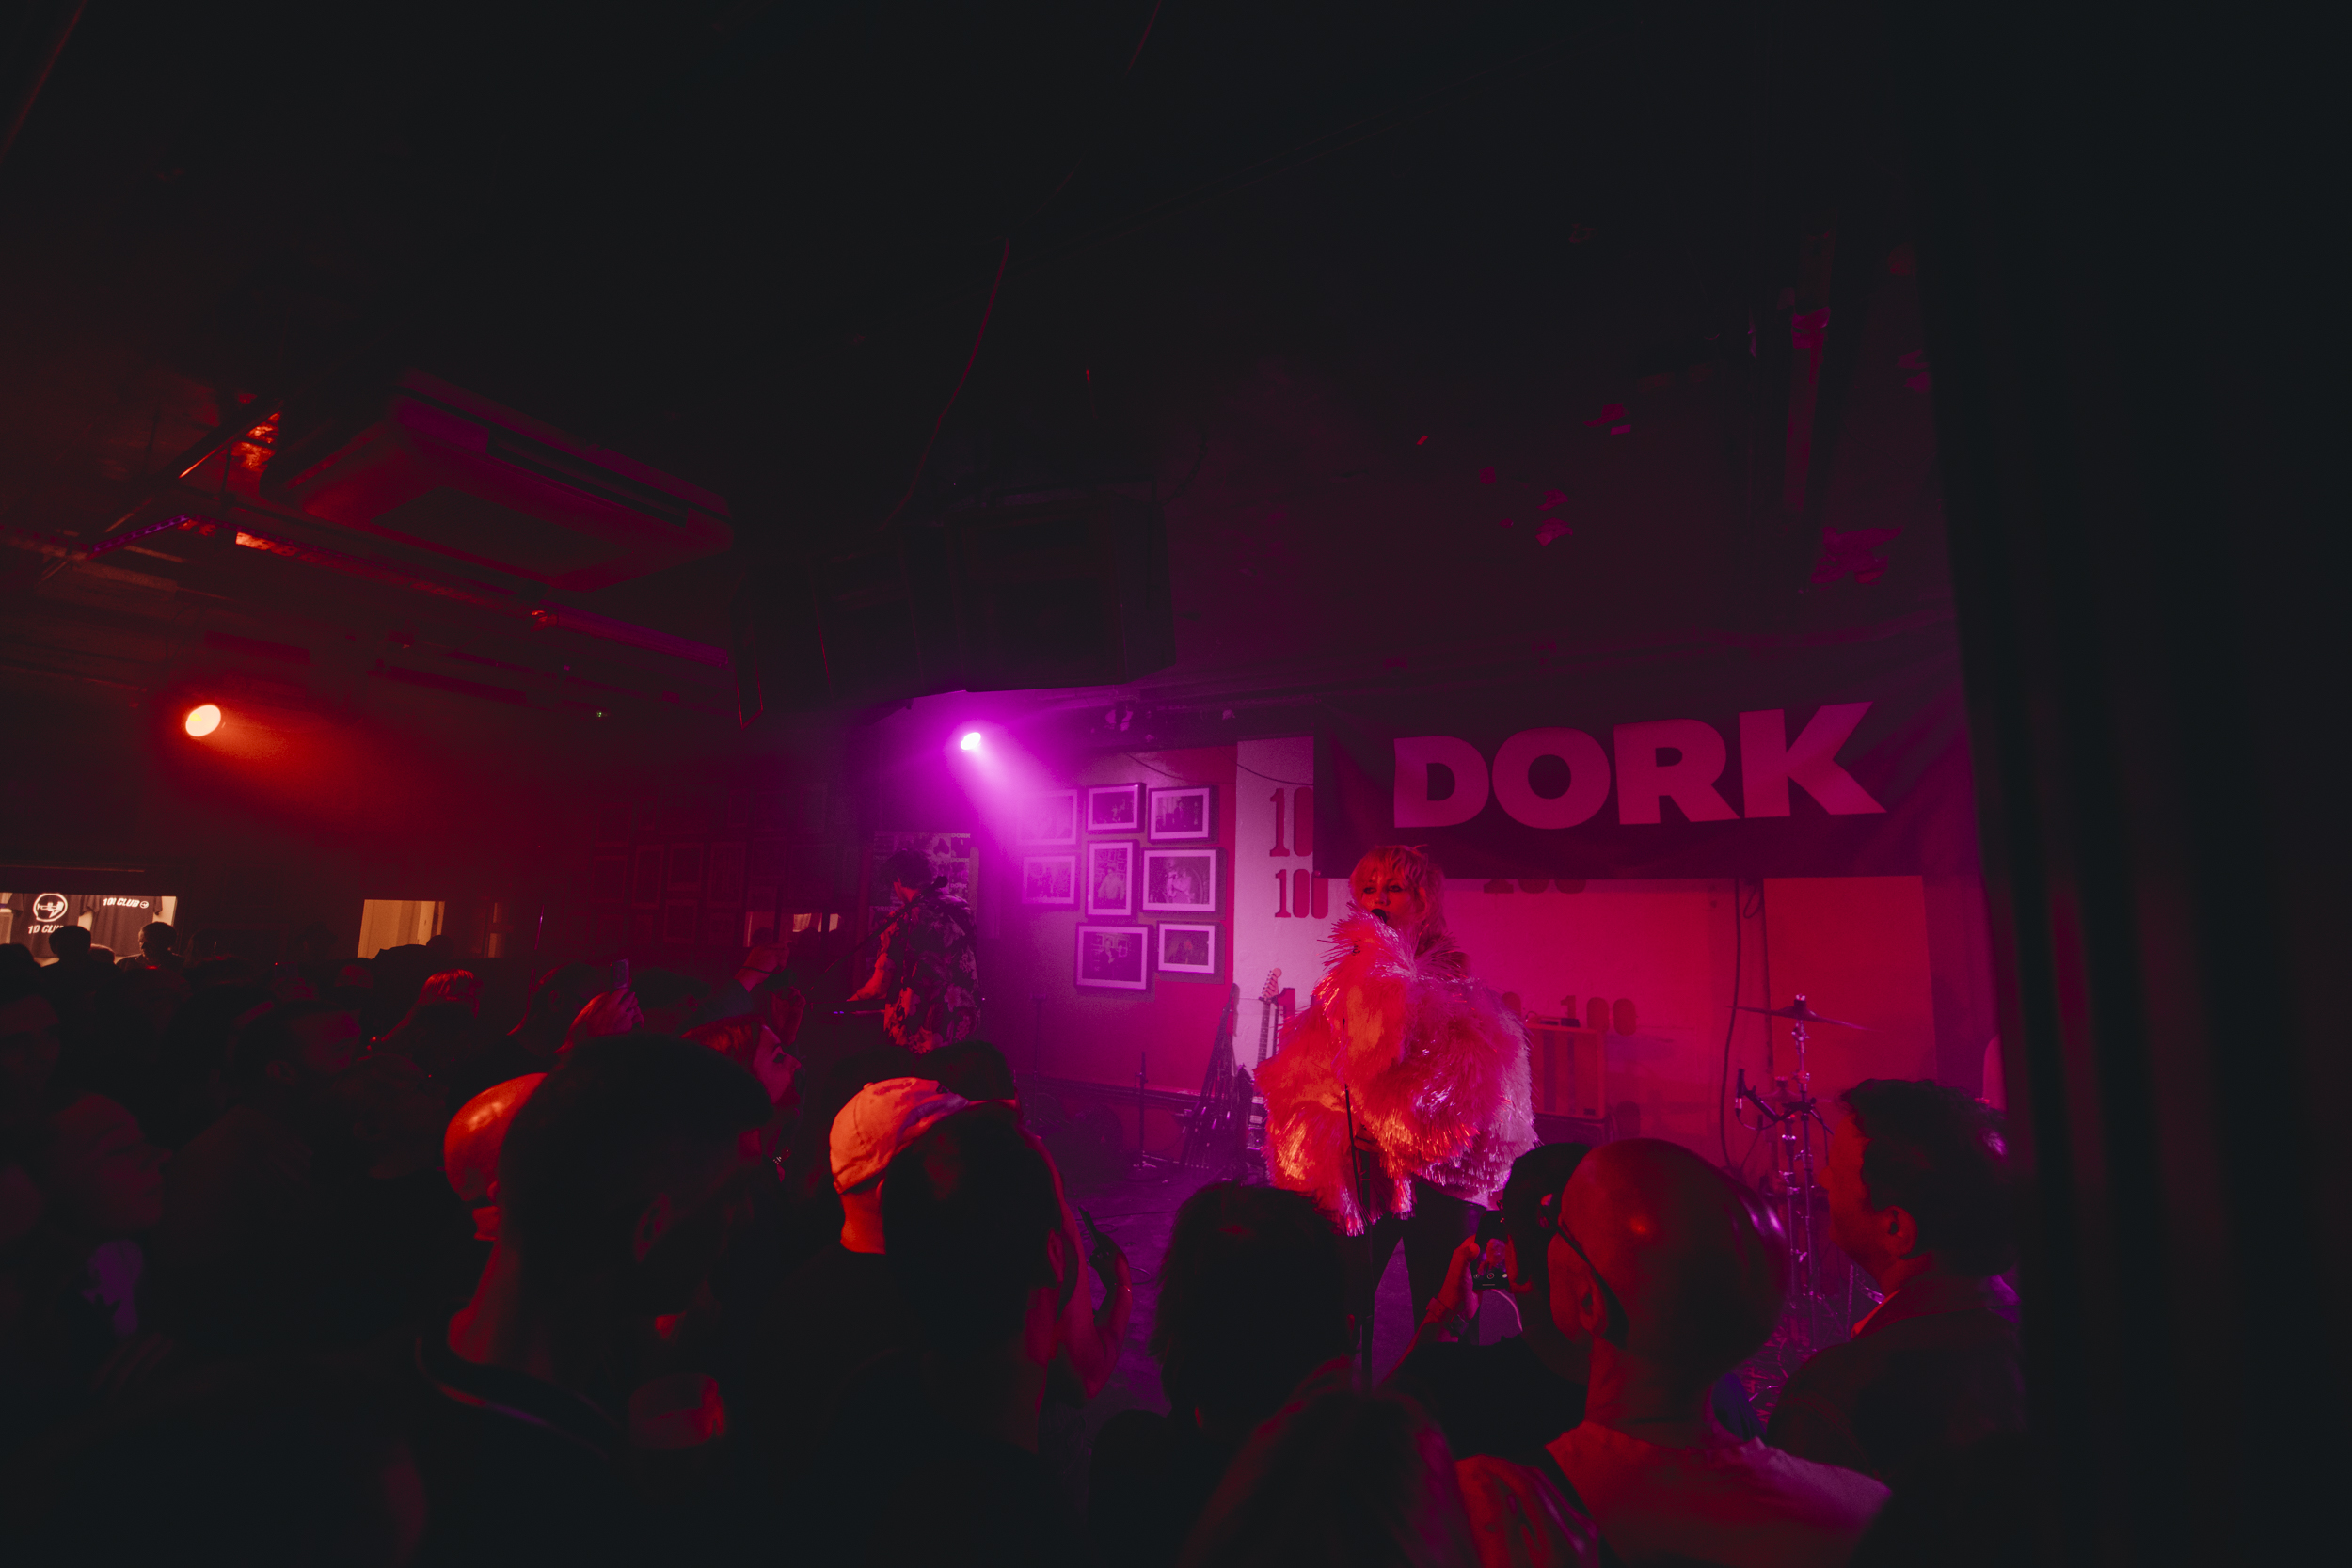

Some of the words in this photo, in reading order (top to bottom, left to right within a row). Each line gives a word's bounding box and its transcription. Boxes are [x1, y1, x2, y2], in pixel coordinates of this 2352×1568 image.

[1394, 701, 1887, 830] DORK
[116, 897, 140, 908] CLUB
[1275, 868, 1329, 920] 100
